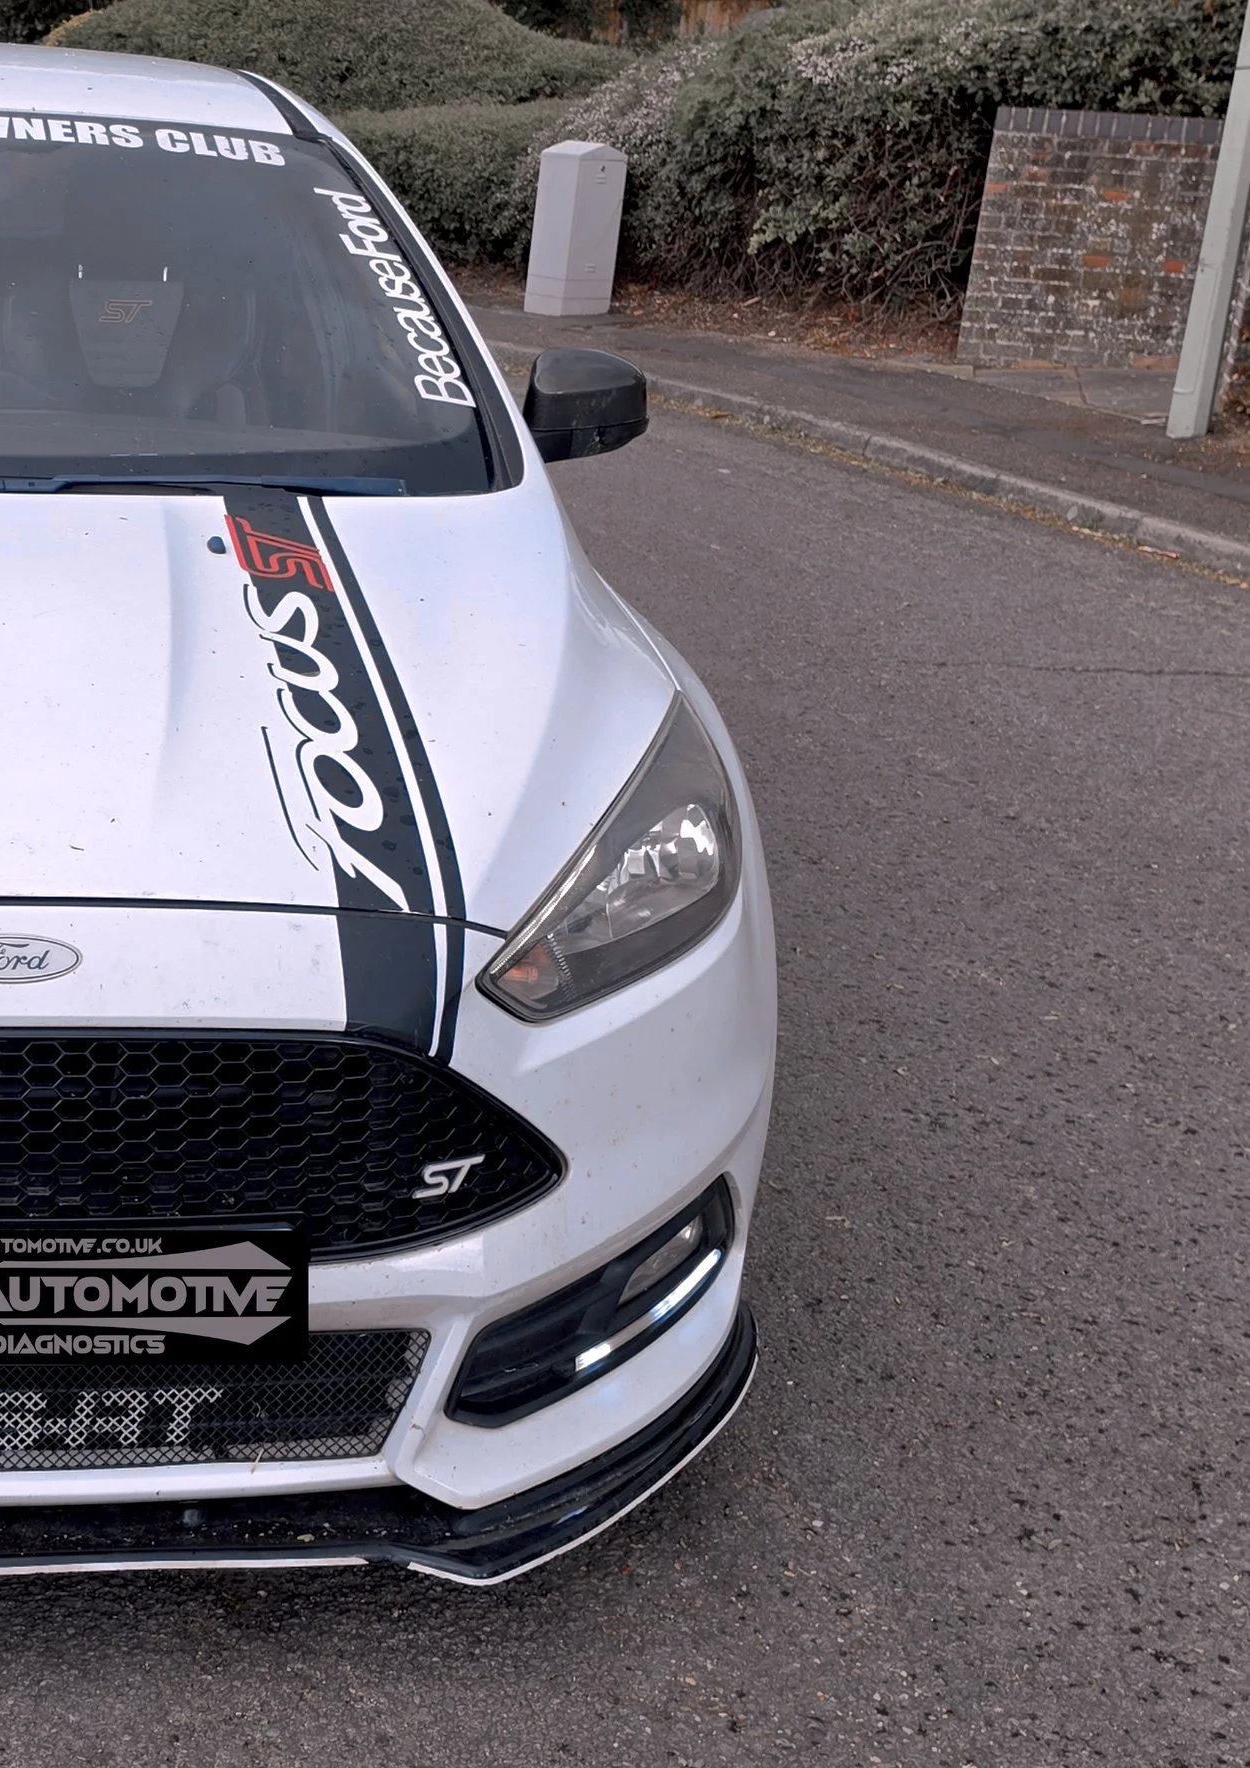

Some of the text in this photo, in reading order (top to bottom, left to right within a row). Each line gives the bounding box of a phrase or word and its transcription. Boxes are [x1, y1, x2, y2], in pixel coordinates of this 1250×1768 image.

[155, 128, 285, 166] CLUB
[98, 299, 153, 324] ST
[313, 187, 477, 408] BecauseFord
[224, 514, 335, 593] ST
[411, 1154, 486, 1199] ST
